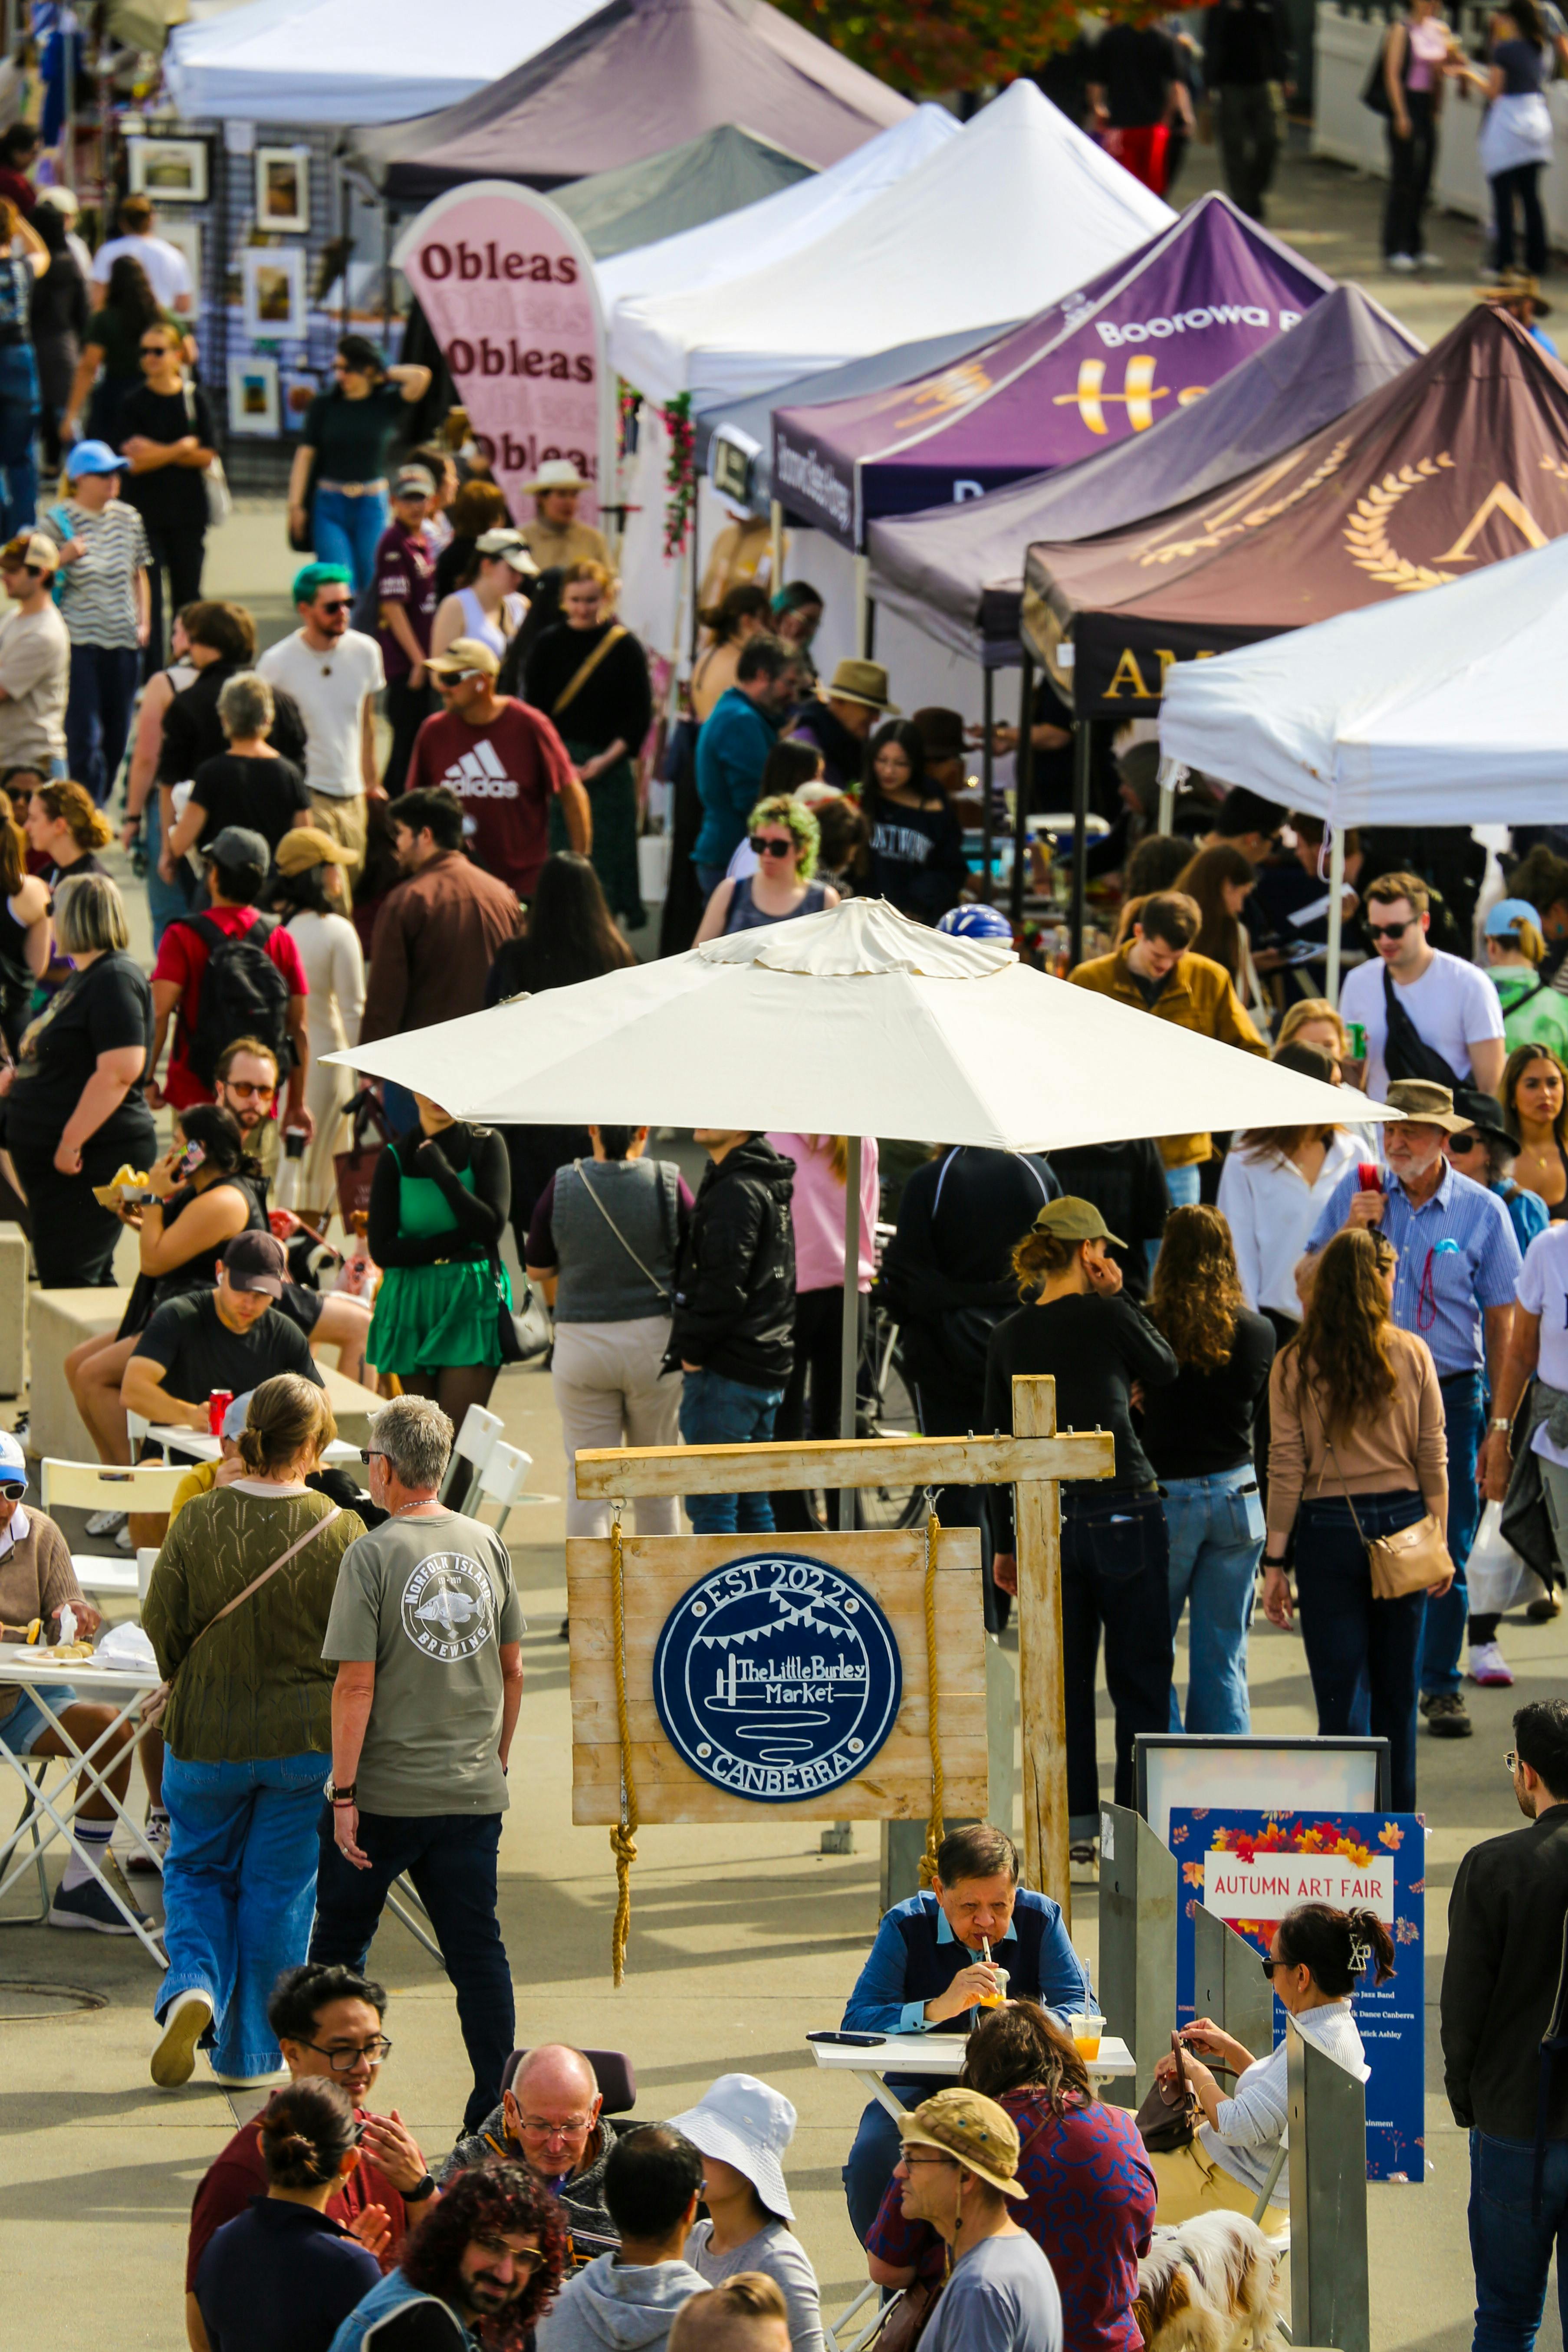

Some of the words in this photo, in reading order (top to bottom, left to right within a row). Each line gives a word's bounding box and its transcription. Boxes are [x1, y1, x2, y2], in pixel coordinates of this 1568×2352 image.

[421, 241, 578, 283] Obleas
[1094, 305, 1269, 347] Boorowa
[446, 338, 594, 383] Obleas
[475, 431, 597, 479] blea
[405, 1557, 449, 1605] NORFOLK
[454, 1557, 491, 1599] ISLAND
[704, 1565, 760, 1607] EST
[770, 1563, 846, 1606] 2022
[417, 1626, 487, 1657] BREWING
[712, 1752, 852, 1793] CANBERRA
[1215, 1876, 1289, 1896] AUTUMN
[1297, 1878, 1333, 1898] ART
[1341, 1879, 1384, 1899] FAIR
[1361, 1991, 1375, 1999] Jazz
[1382, 2011, 1414, 2019] Canberra
[1378, 2030, 1402, 2040] Ashley
